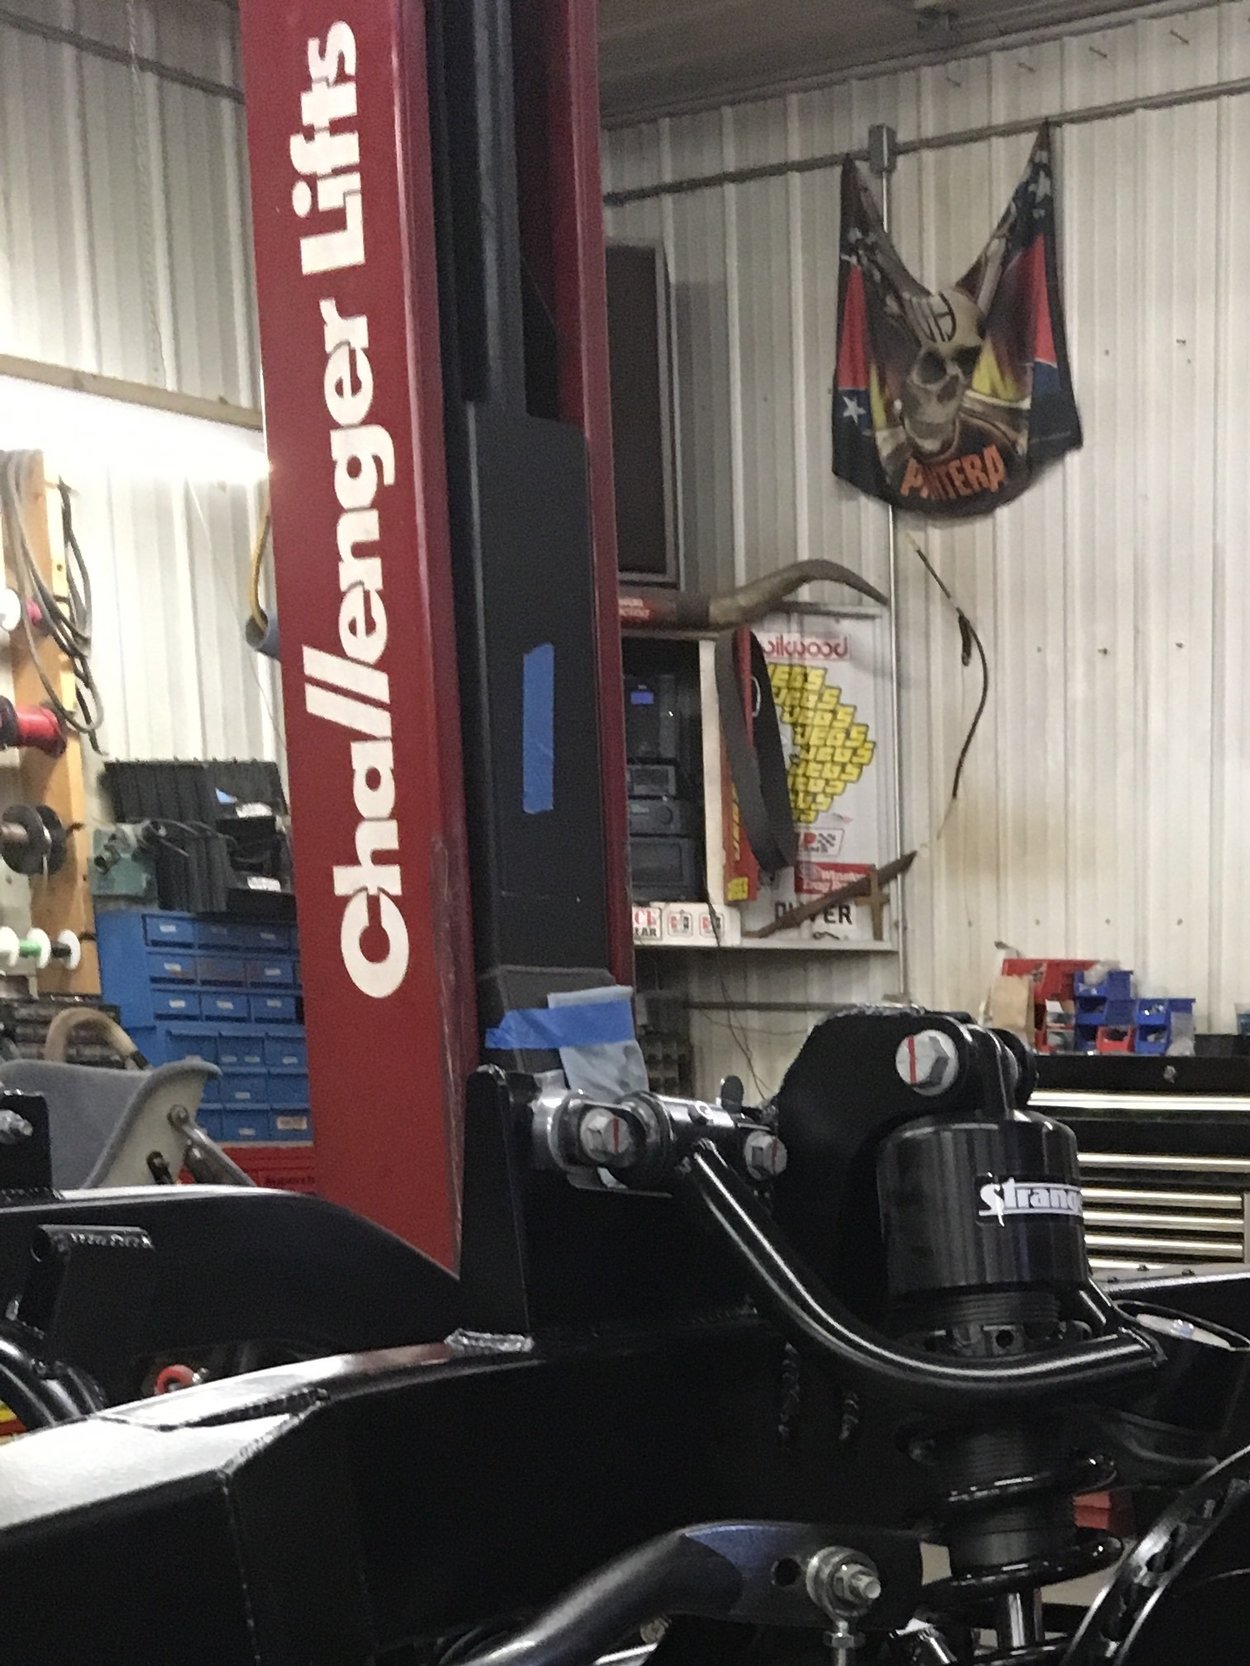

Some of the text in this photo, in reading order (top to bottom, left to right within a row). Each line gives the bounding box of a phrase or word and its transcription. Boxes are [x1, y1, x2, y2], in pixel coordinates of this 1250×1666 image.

[289, 20, 409, 999] Challenger Lifts
[979, 1173, 1082, 1226] Strang
